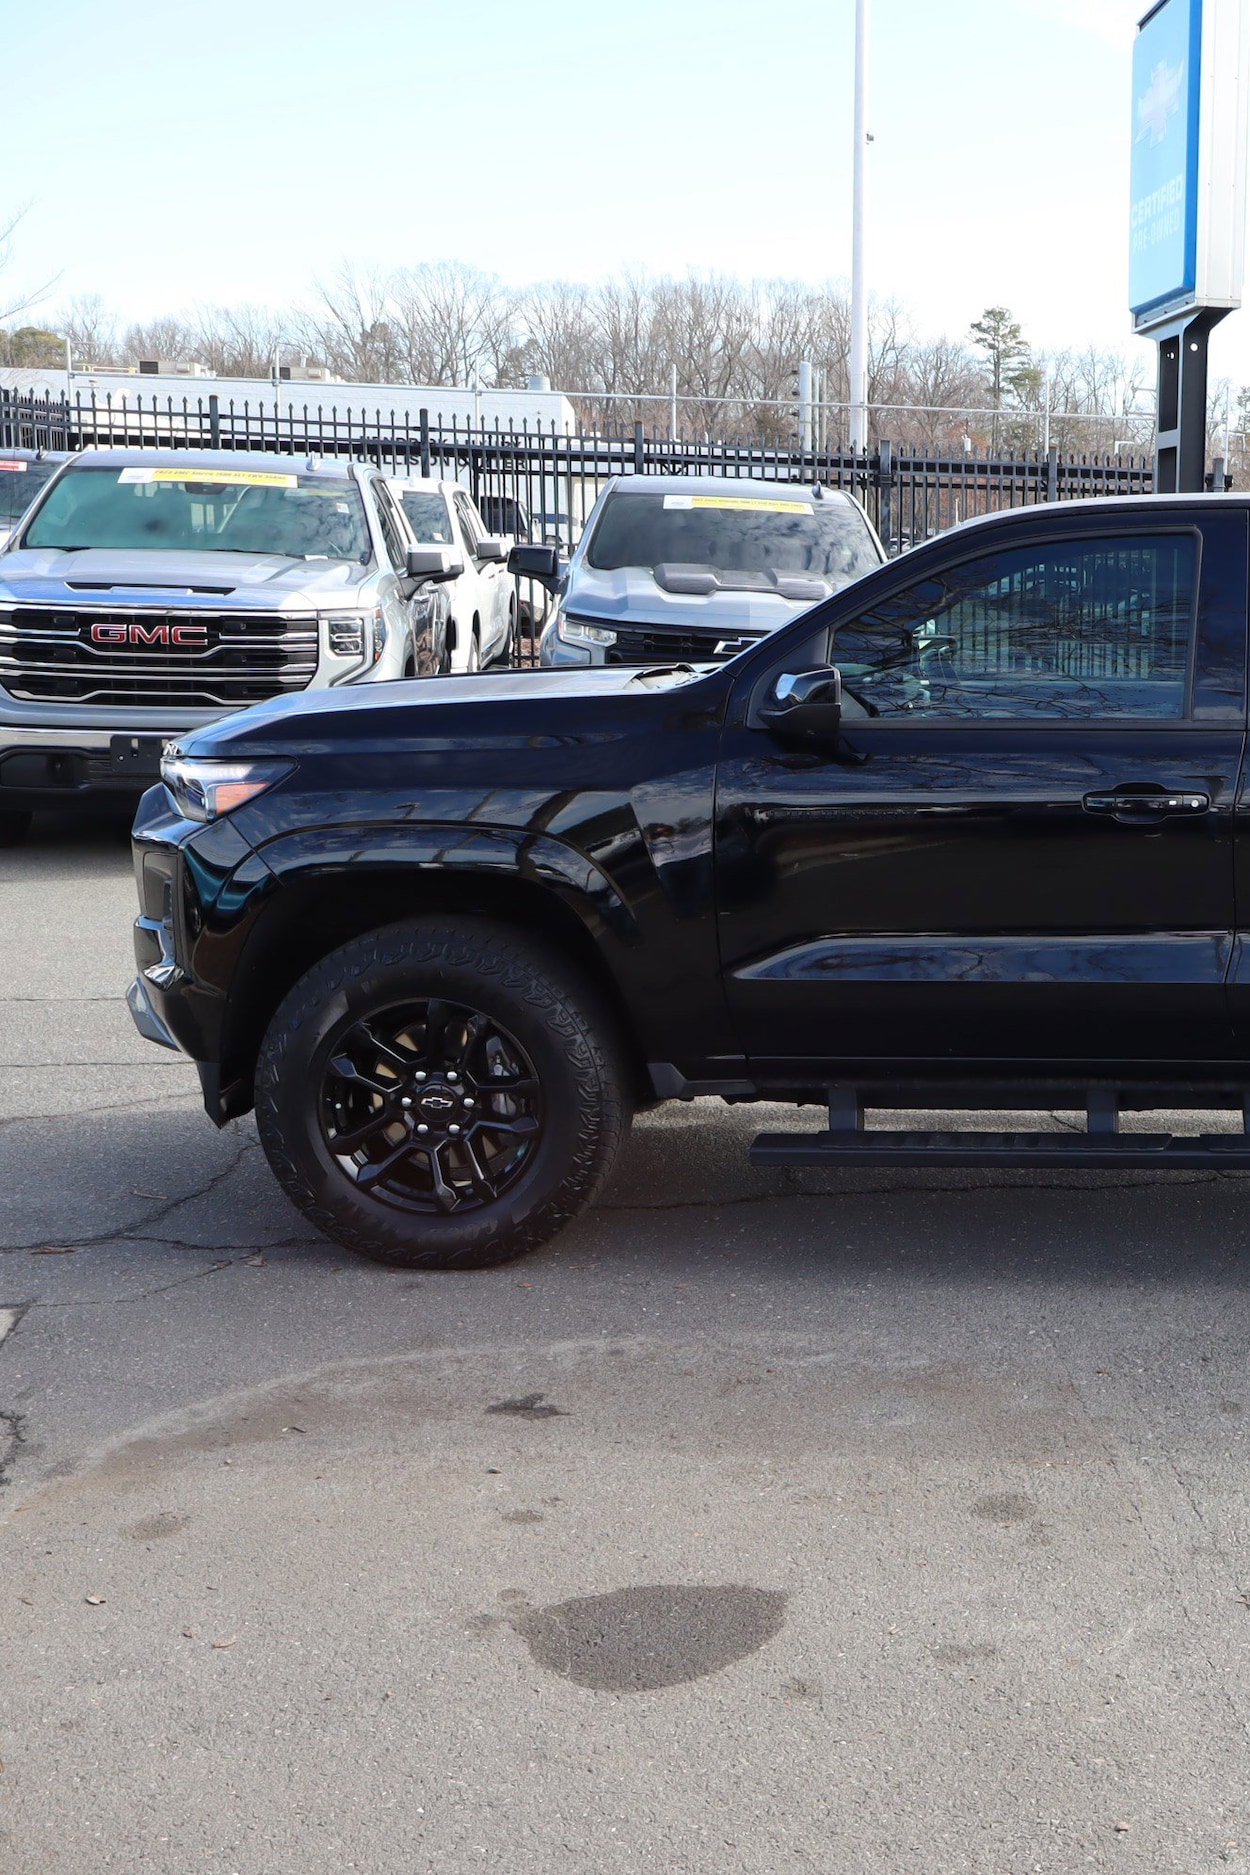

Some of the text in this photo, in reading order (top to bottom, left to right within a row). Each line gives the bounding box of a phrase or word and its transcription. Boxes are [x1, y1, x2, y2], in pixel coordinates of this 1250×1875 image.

[1130, 173, 1183, 228] CERTIFIED
[1131, 207, 1180, 251] PRE-OWNED
[357, 453, 450, 466] COLLISON
[91, 623, 208, 645] GMC
